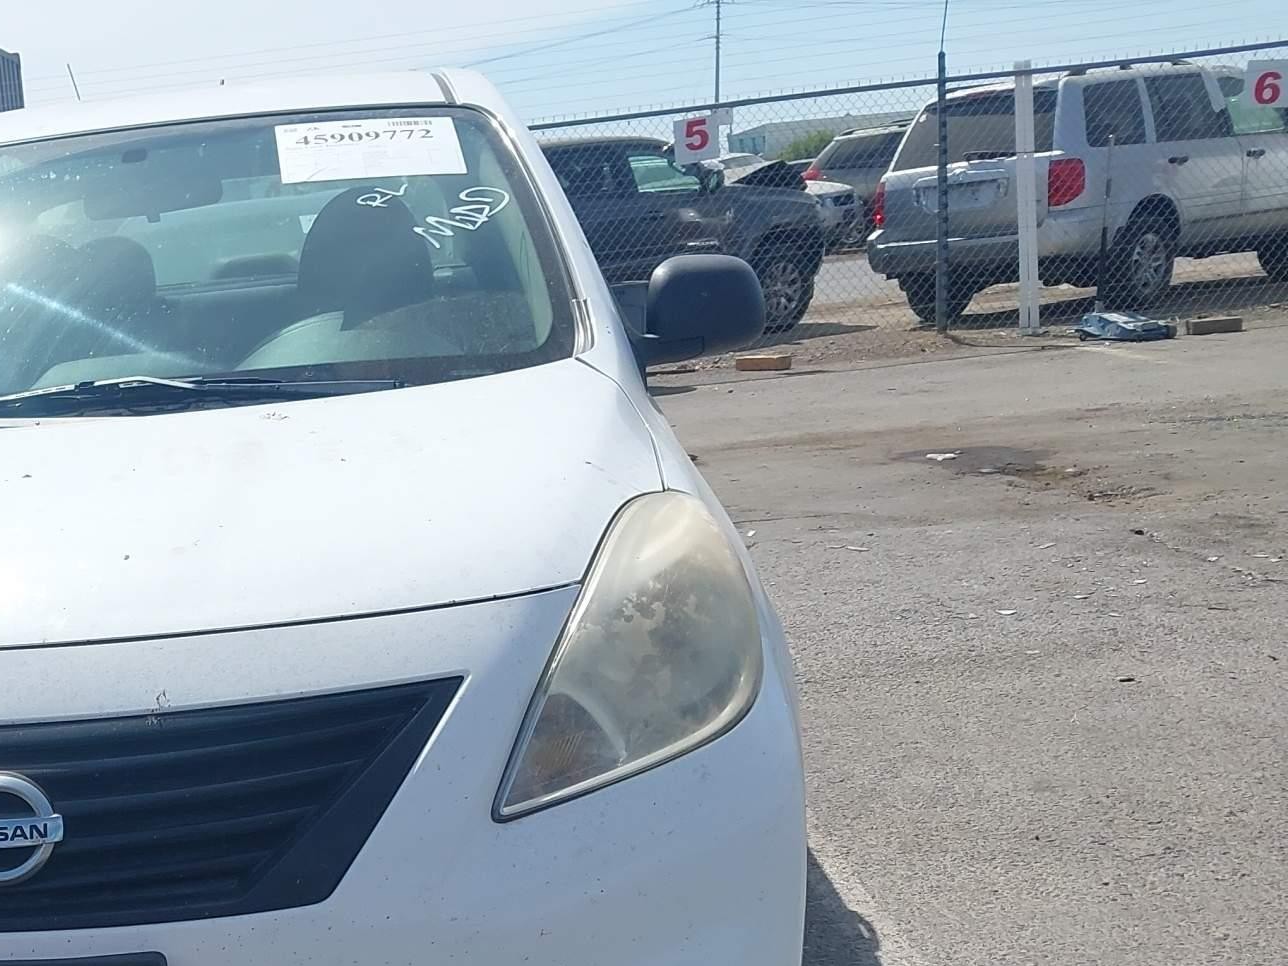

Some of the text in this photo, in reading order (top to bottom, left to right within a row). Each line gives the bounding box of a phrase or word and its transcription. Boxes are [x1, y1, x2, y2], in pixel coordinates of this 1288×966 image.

[1254, 71, 1283, 105] 6
[295, 128, 434, 146] 45909772
[685, 118, 710, 151] 5
